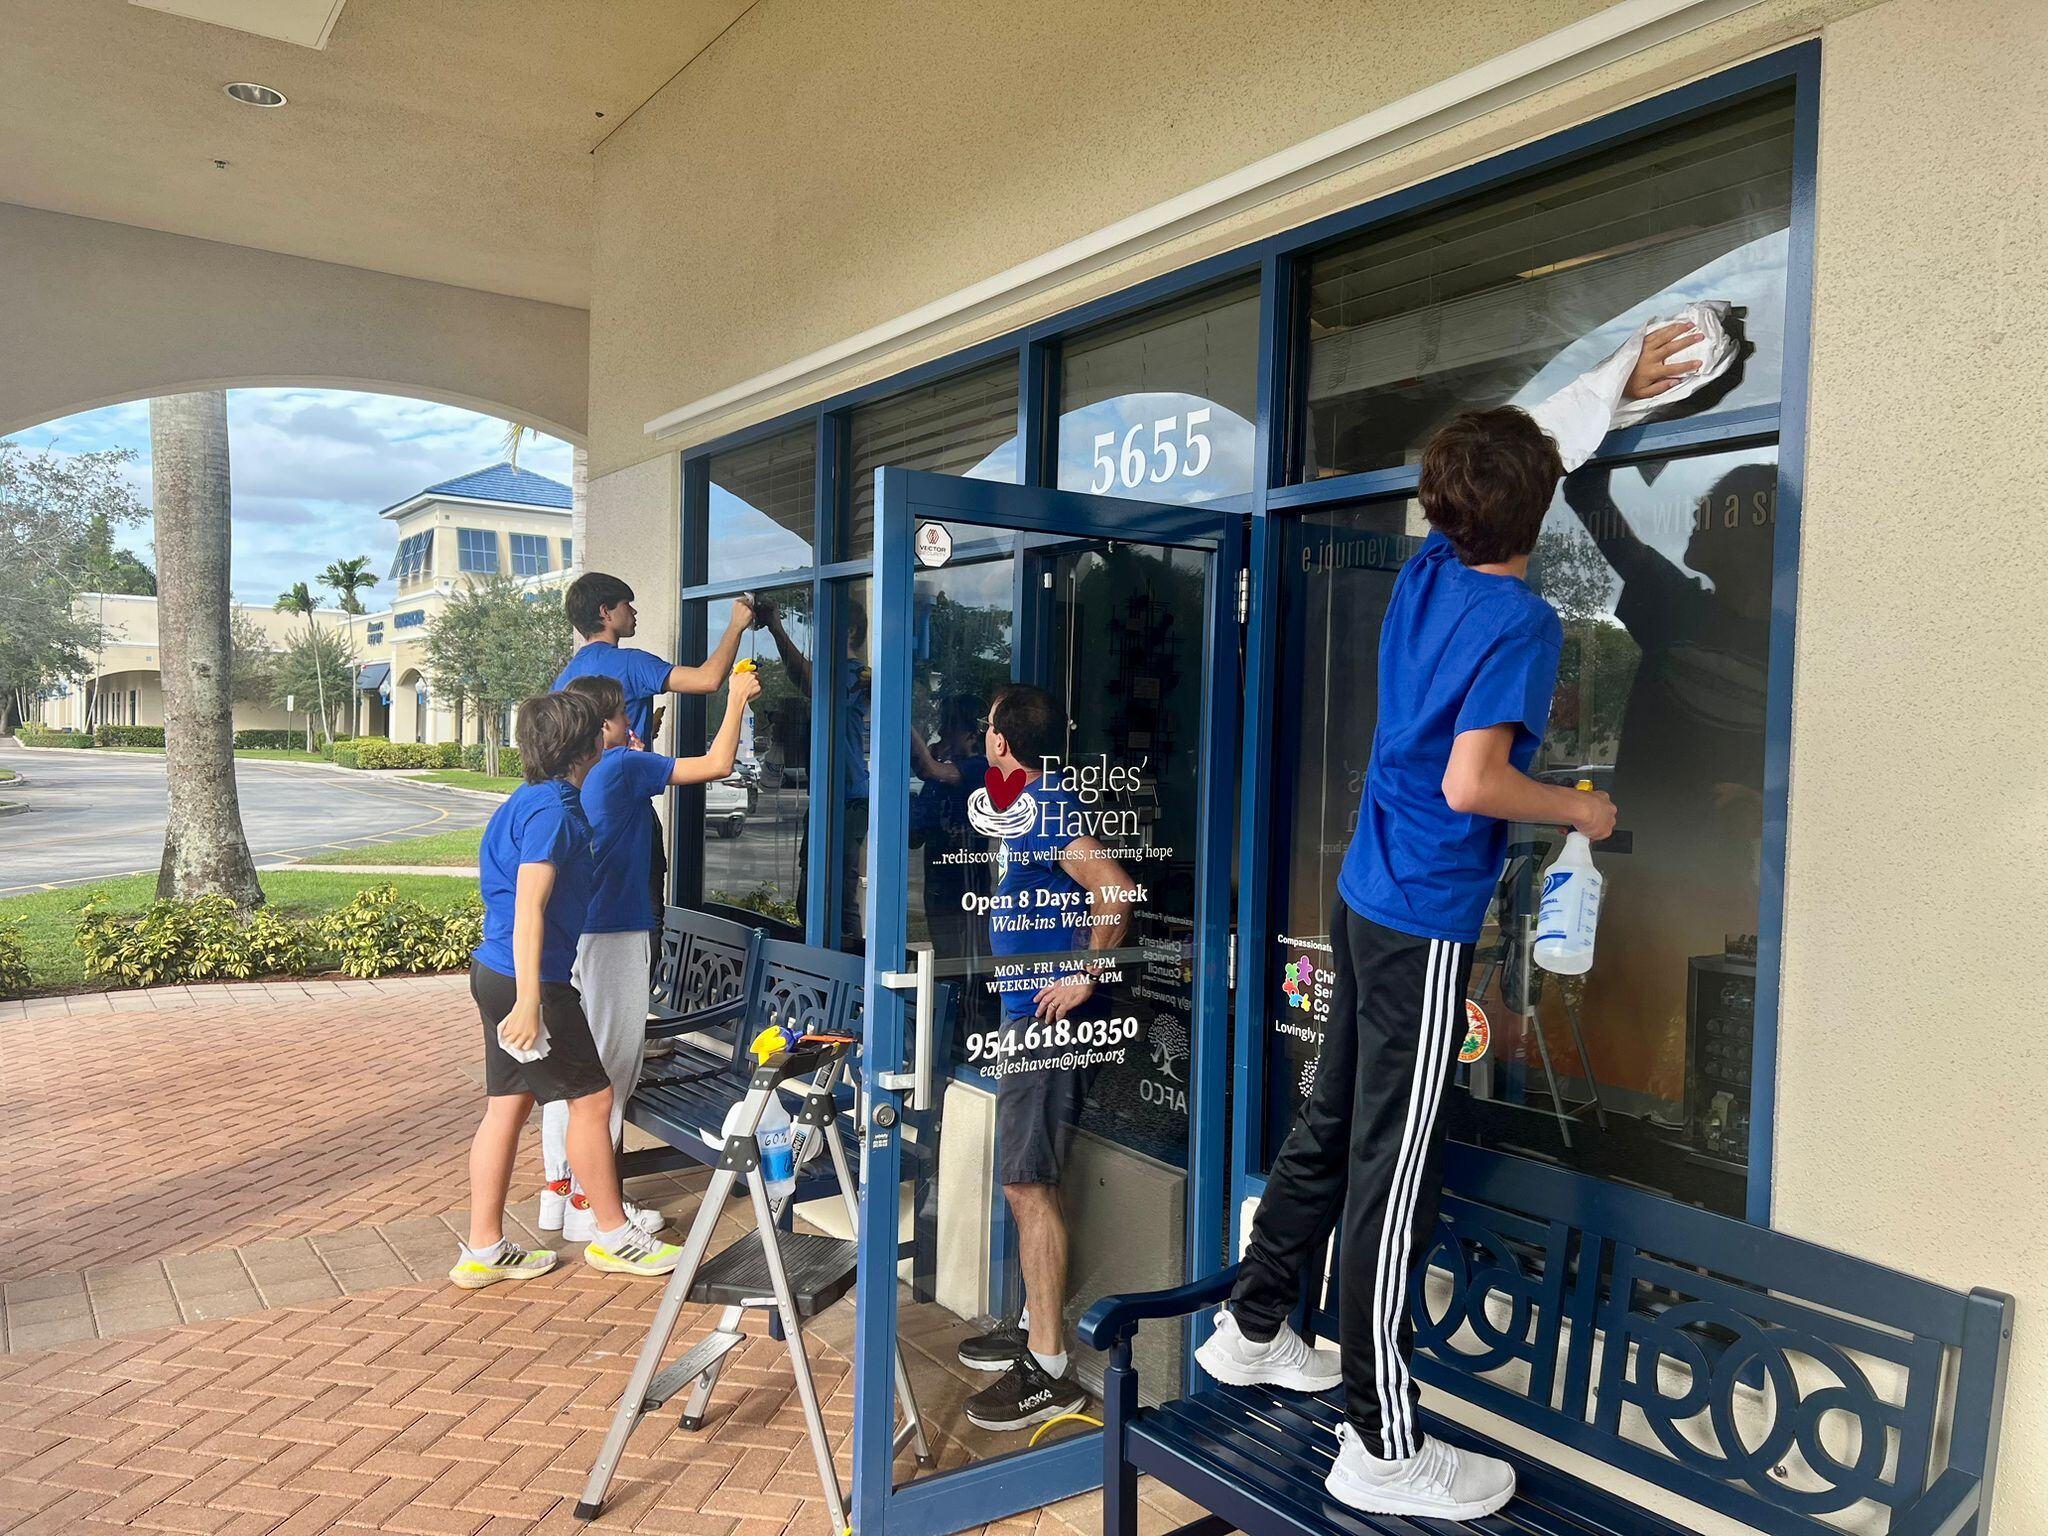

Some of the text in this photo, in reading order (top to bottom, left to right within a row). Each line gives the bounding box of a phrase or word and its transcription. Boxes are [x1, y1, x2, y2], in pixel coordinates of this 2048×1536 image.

[1090, 407, 1211, 494] 5655
[1317, 537, 1389, 574] journey
[1723, 494, 1740, 529] a
[919, 544, 946, 553] VECTOR
[1036, 801, 1141, 838] Haven
[1033, 846, 1087, 862] wellness,
[1089, 846, 1143, 861] restoring
[1145, 844, 1173, 860] hope
[961, 883, 1148, 915] Open 8 Days a Week
[992, 911, 1121, 932] Walk-ins Welcome
[993, 964, 1024, 978] MON
[1033, 961, 1054, 974] FRI
[1059, 960, 1084, 973] 9AM
[1093, 957, 1116, 969] 7PM
[986, 977, 1055, 994] WEEKENDS
[1060, 973, 1091, 986] 10AM
[1098, 970, 1123, 984] 4PM
[965, 1016, 1138, 1062] 954.618.0350
[1275, 1019, 1316, 1044] Lovingly
[980, 1047, 1126, 1079] eagleshaven@jafco.org
[1018, 1388, 1053, 1412] HOKA
